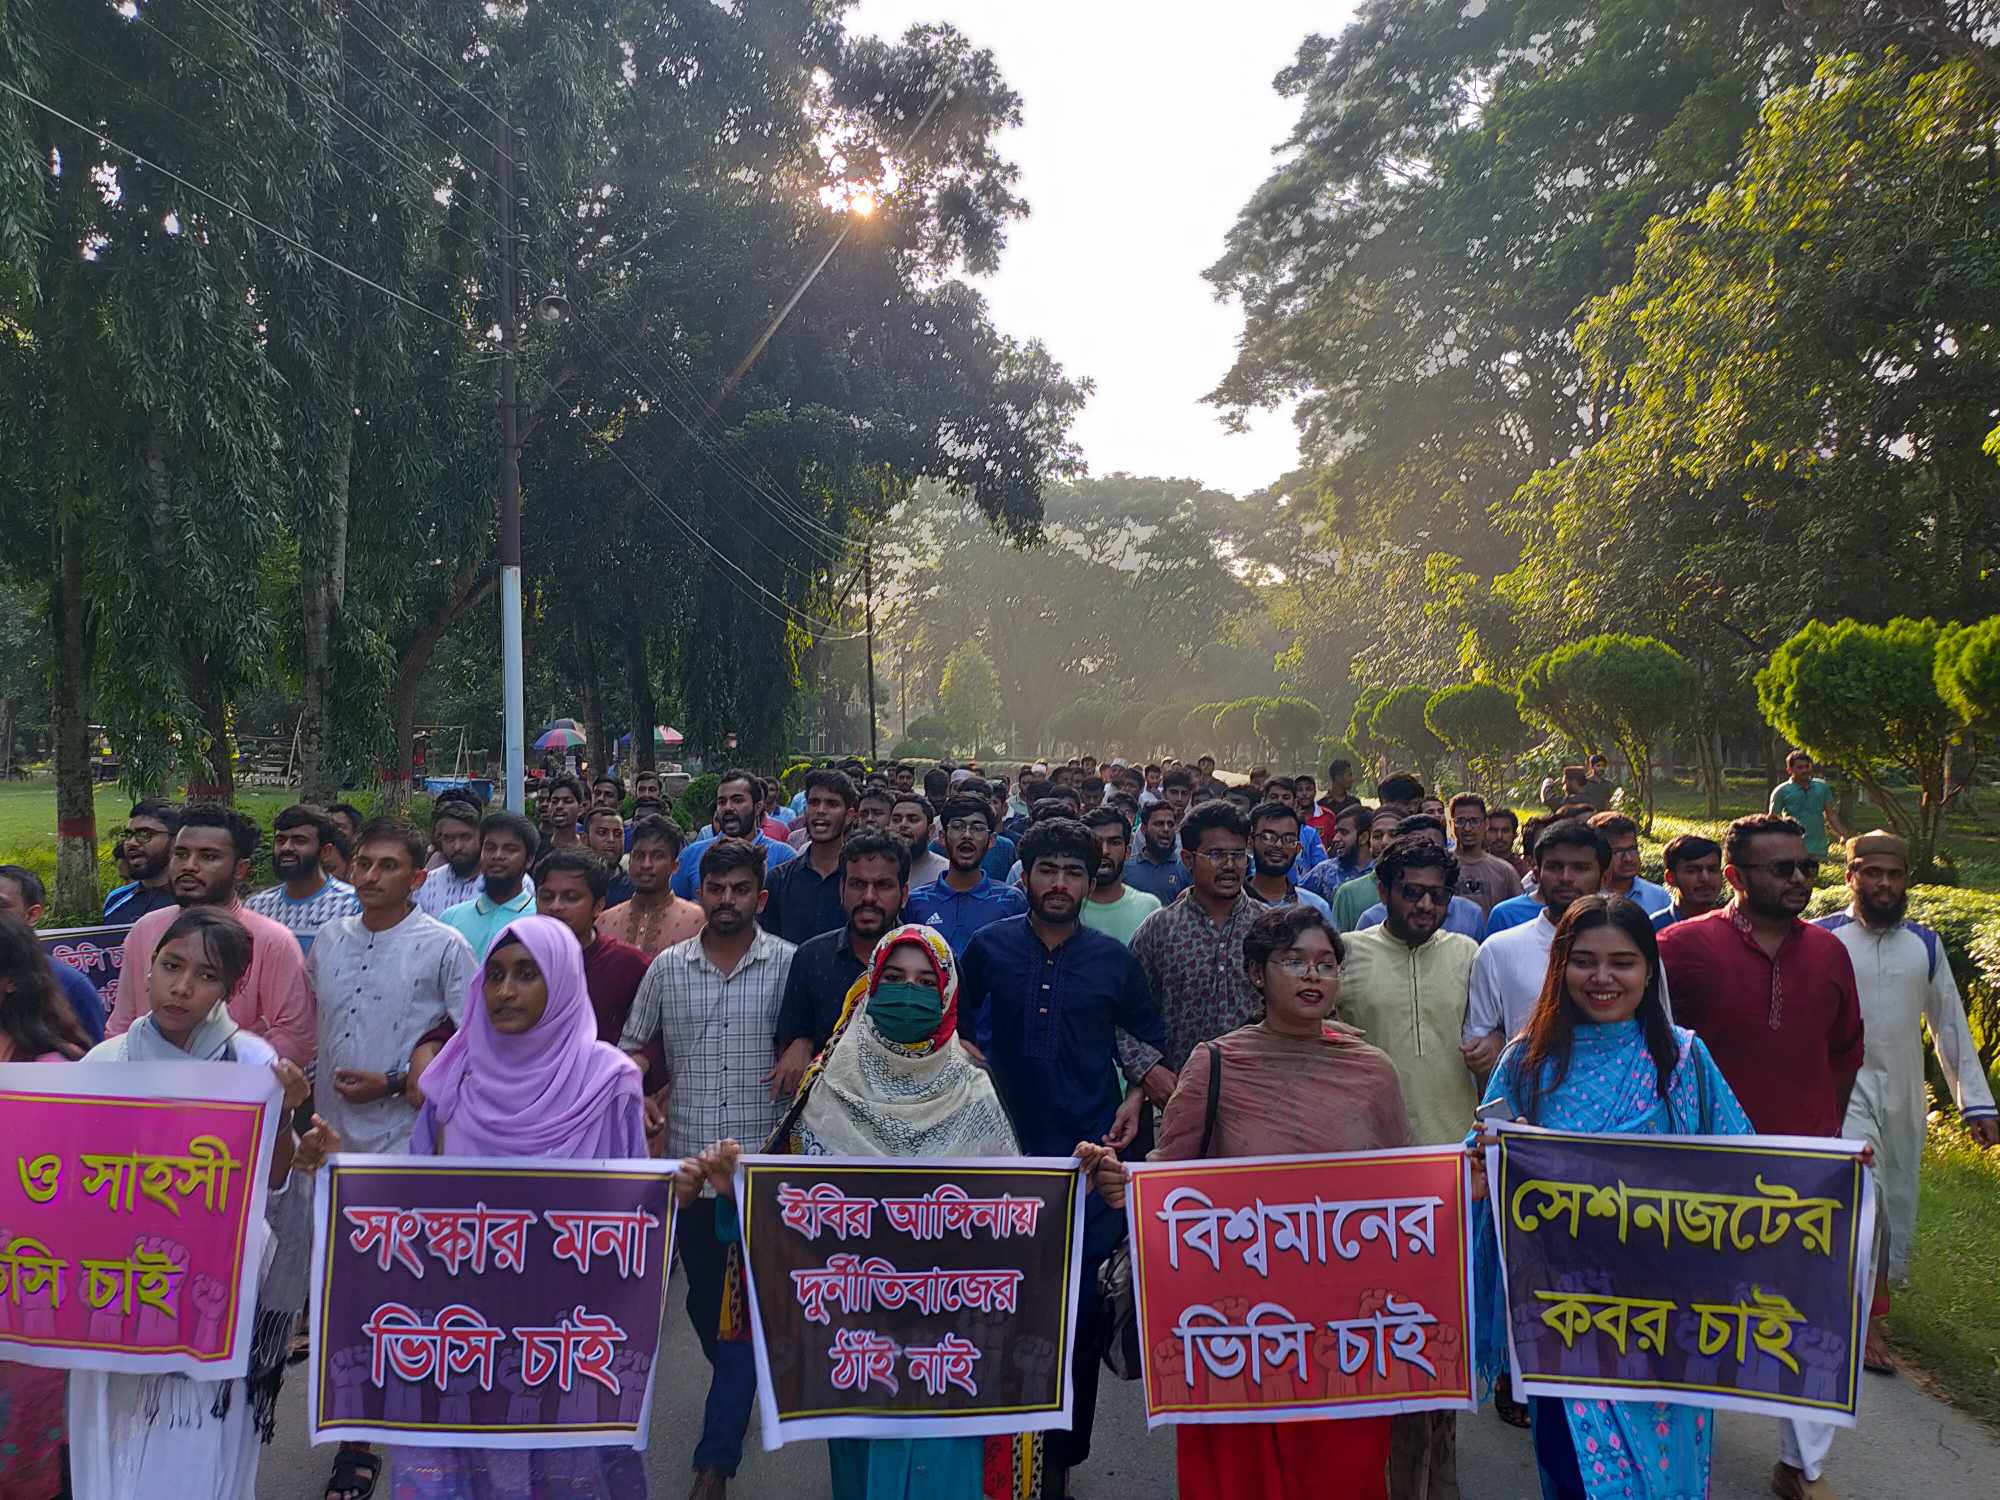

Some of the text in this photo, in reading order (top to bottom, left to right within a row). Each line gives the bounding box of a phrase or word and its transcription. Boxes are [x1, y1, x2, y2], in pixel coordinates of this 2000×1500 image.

[18, 1134, 242, 1218] ও সাহসী
[777, 1182, 1046, 1241] ইবির আঙ্গিনায়
[1511, 1173, 1845, 1257] সেশনজটের
[343, 1201, 659, 1279] সংস্কার মনা
[1156, 1186, 1445, 1278] বিশ্বমানের
[0, 1236, 184, 1319] সি চাই
[790, 1252, 1024, 1325] দুর্নীতিবাজের
[361, 1301, 628, 1396] ভিসি চাই
[828, 1328, 981, 1397] ঠাঁই নাই
[1171, 1294, 1439, 1389] ভিসি চাই
[1533, 1283, 1809, 1376] কবর চাই
